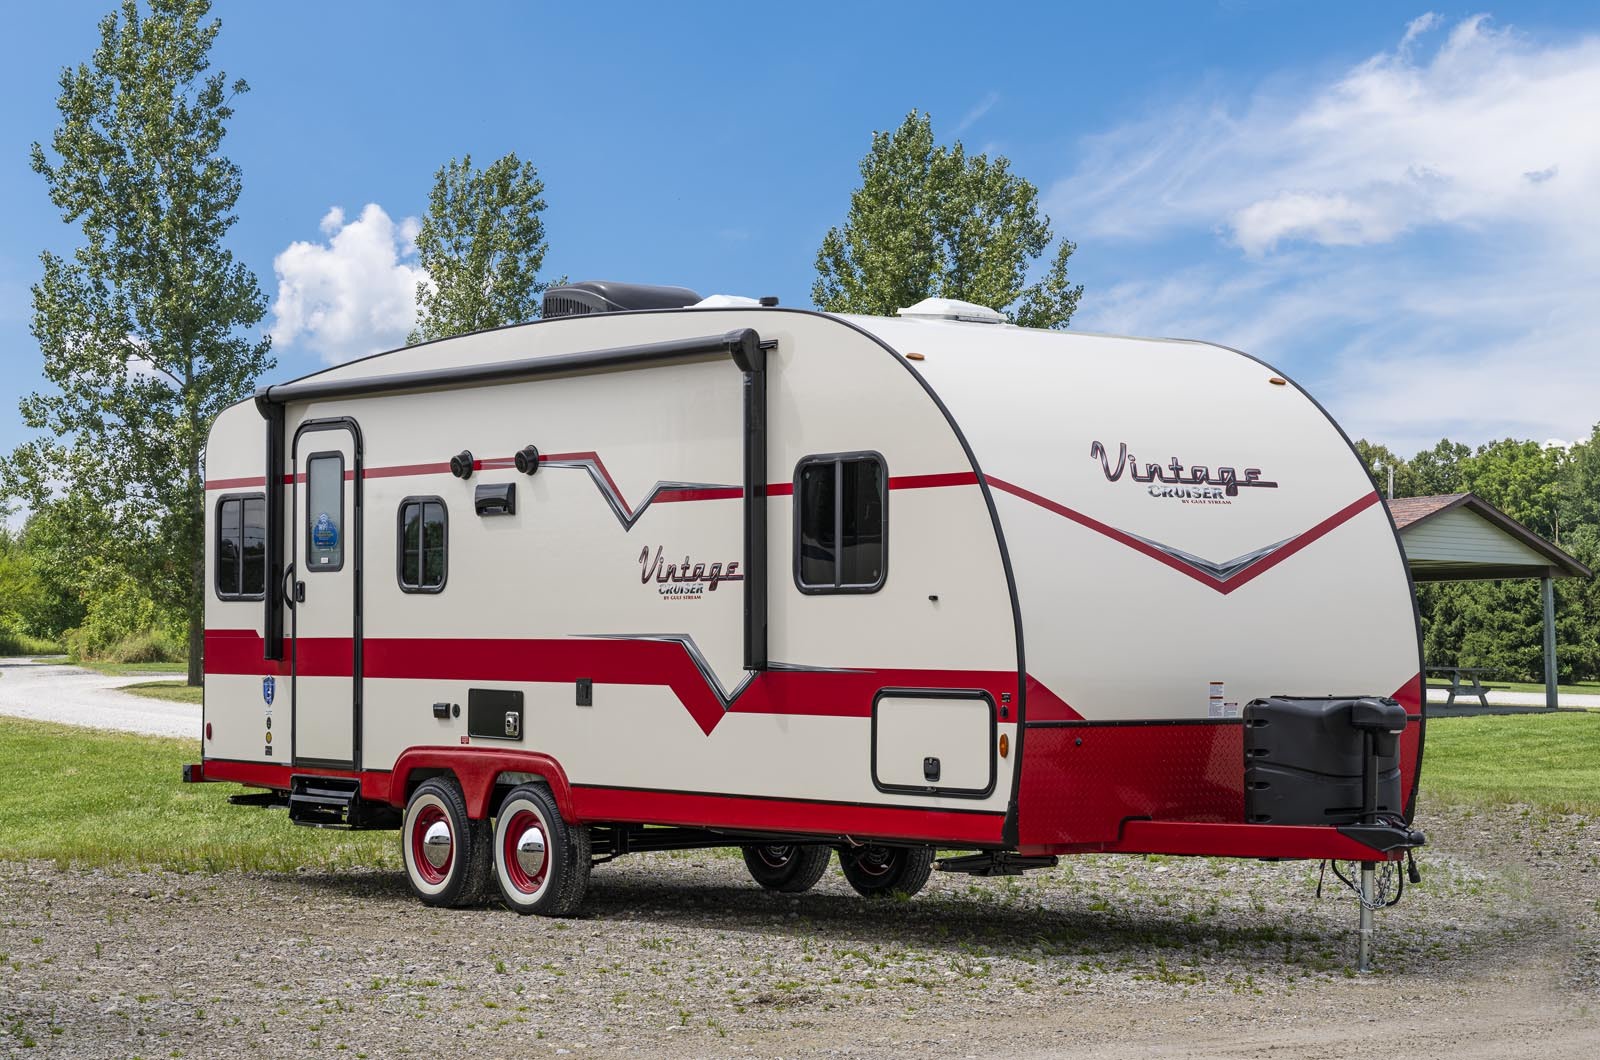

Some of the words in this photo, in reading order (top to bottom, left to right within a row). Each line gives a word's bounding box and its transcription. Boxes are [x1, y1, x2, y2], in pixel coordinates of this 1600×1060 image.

[1091, 441, 1278, 496] Vintage
[1148, 485, 1224, 499] CRUISER
[639, 545, 744, 591] Vintage
[658, 583, 703, 594] CRUISER
